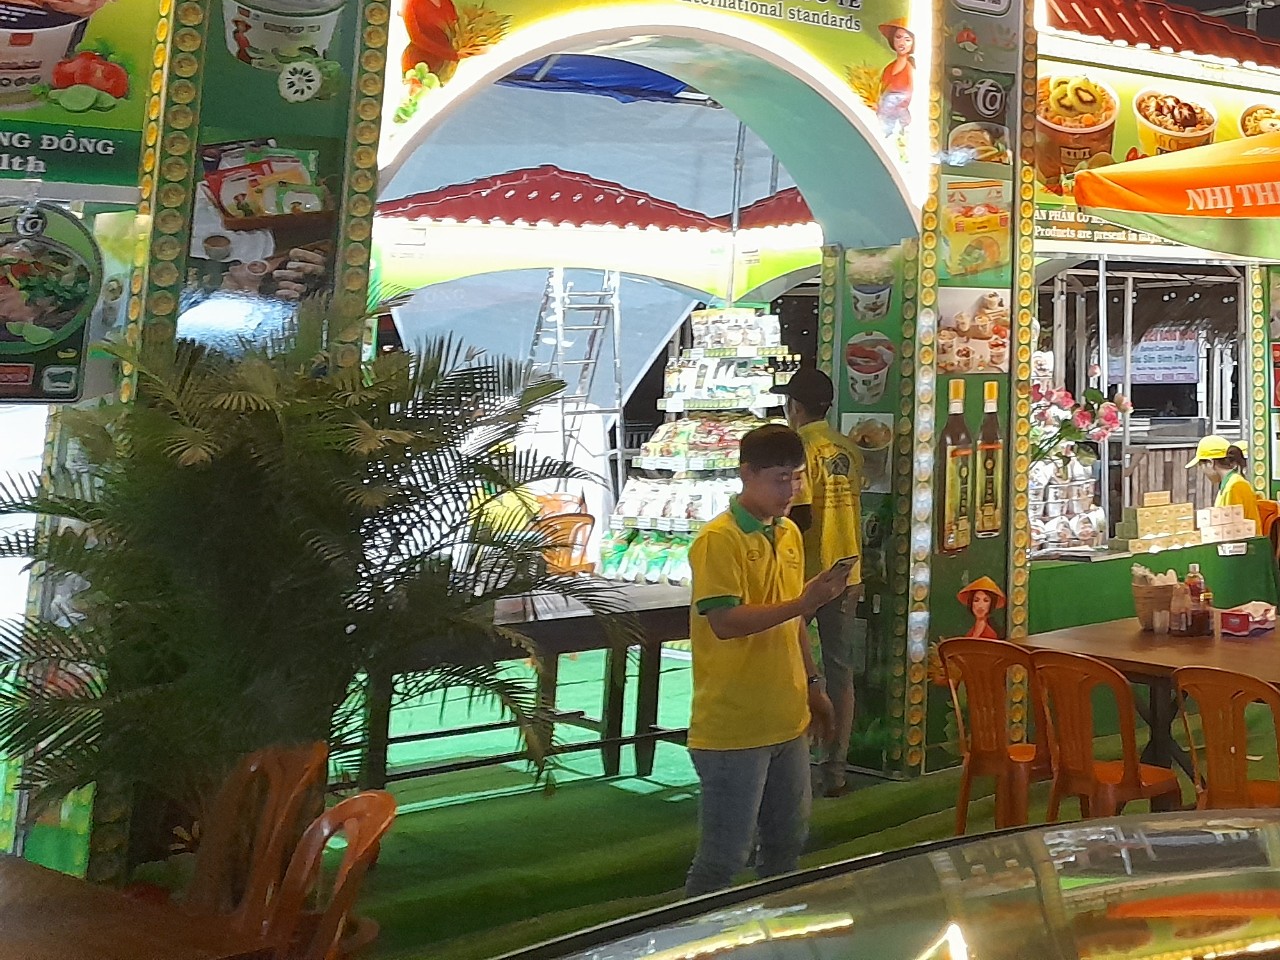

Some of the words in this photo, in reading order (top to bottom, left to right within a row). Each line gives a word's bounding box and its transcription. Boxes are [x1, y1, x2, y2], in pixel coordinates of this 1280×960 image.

[788, 6, 861, 31] standards
[40, 130, 115, 155] ĐỒNG
[1186, 185, 1235, 214] NHỊ
[1034, 205, 1047, 221] ẢN
[1077, 229, 1092, 239] are
